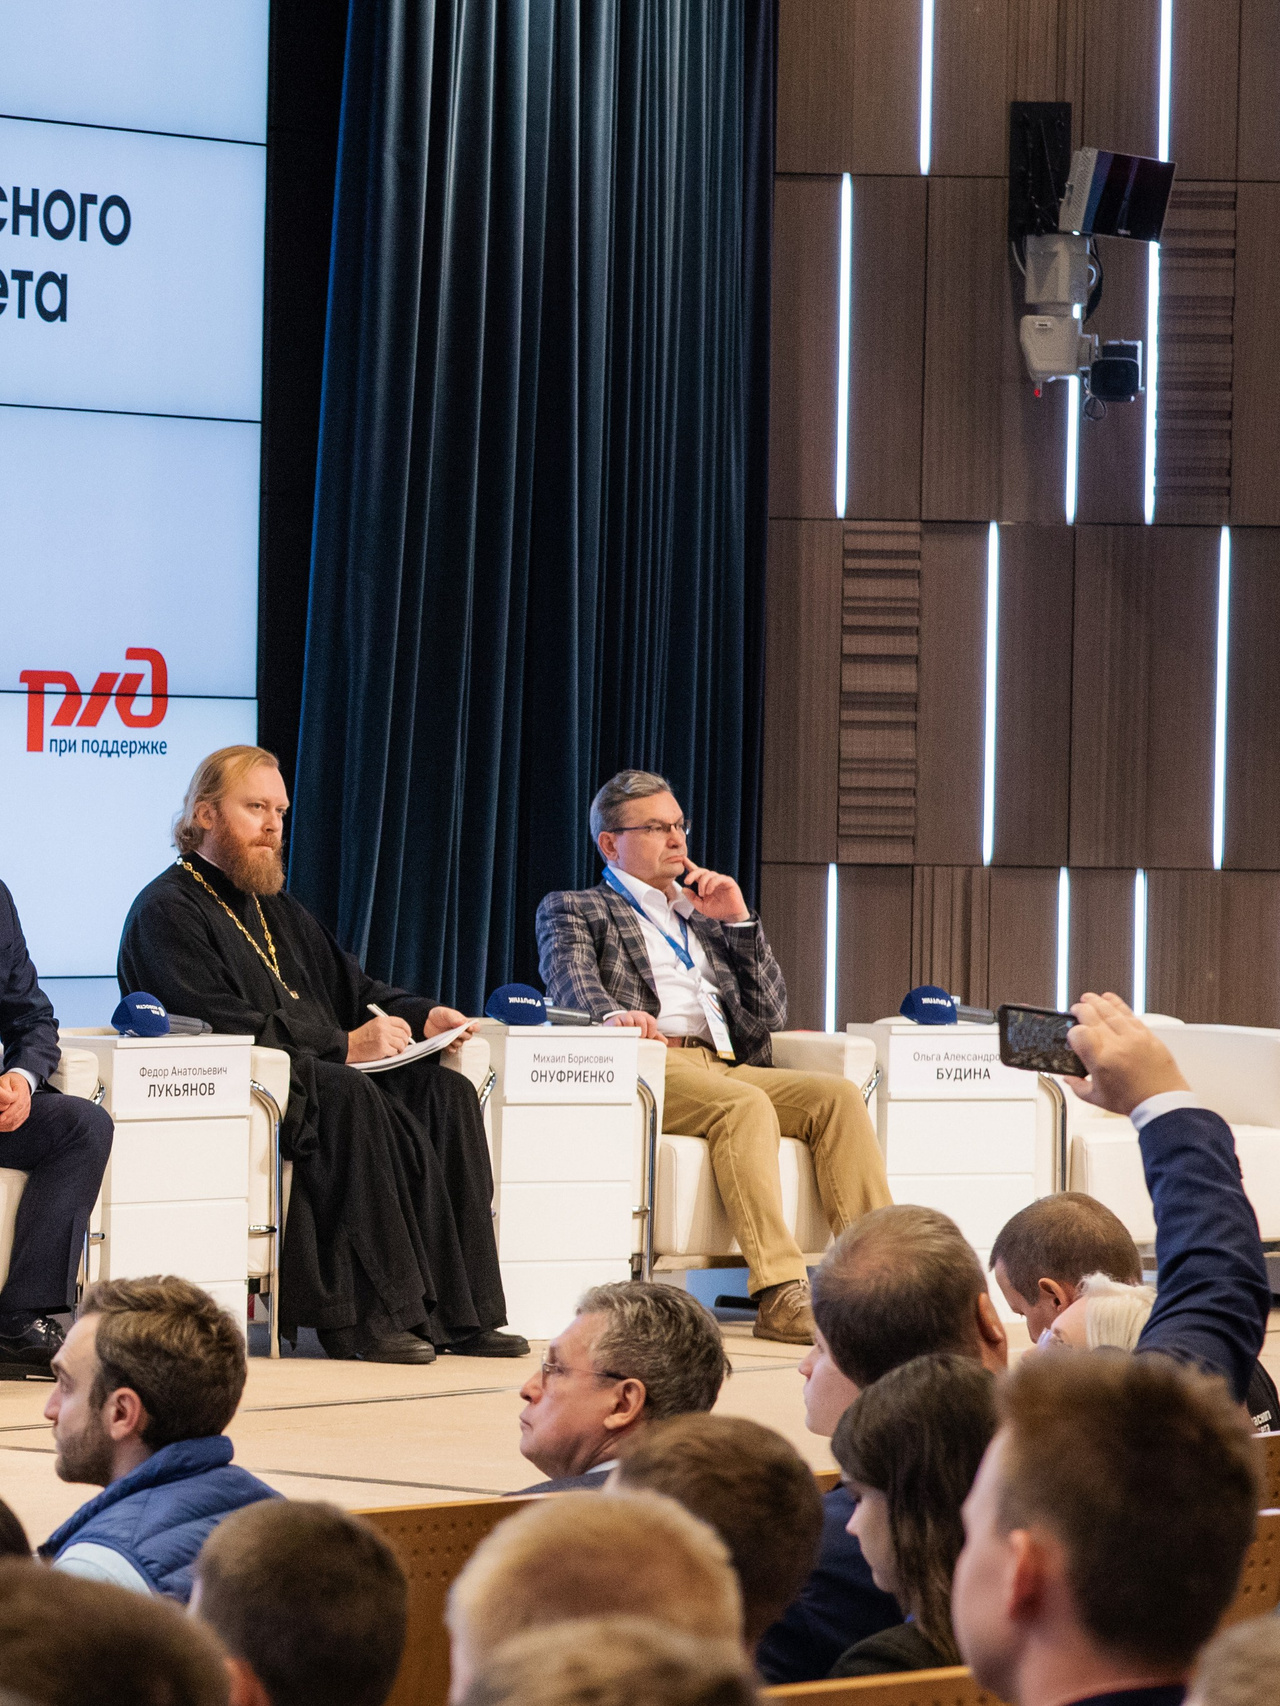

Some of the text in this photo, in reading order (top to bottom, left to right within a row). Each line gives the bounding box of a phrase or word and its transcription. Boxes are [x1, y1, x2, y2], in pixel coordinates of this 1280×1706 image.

[50, 737, 168, 758] при поддержке
[533, 1053, 614, 1065] Михаил Борисович
[913, 1052, 941, 1062] Ольга
[139, 1066, 227, 1079] Федор Анатольевич
[531, 1070, 615, 1083] ОНУФРИЕНКО
[936, 1068, 991, 1082] БУДИНА
[147, 1083, 215, 1098] ЛУКЬЯНОВ
